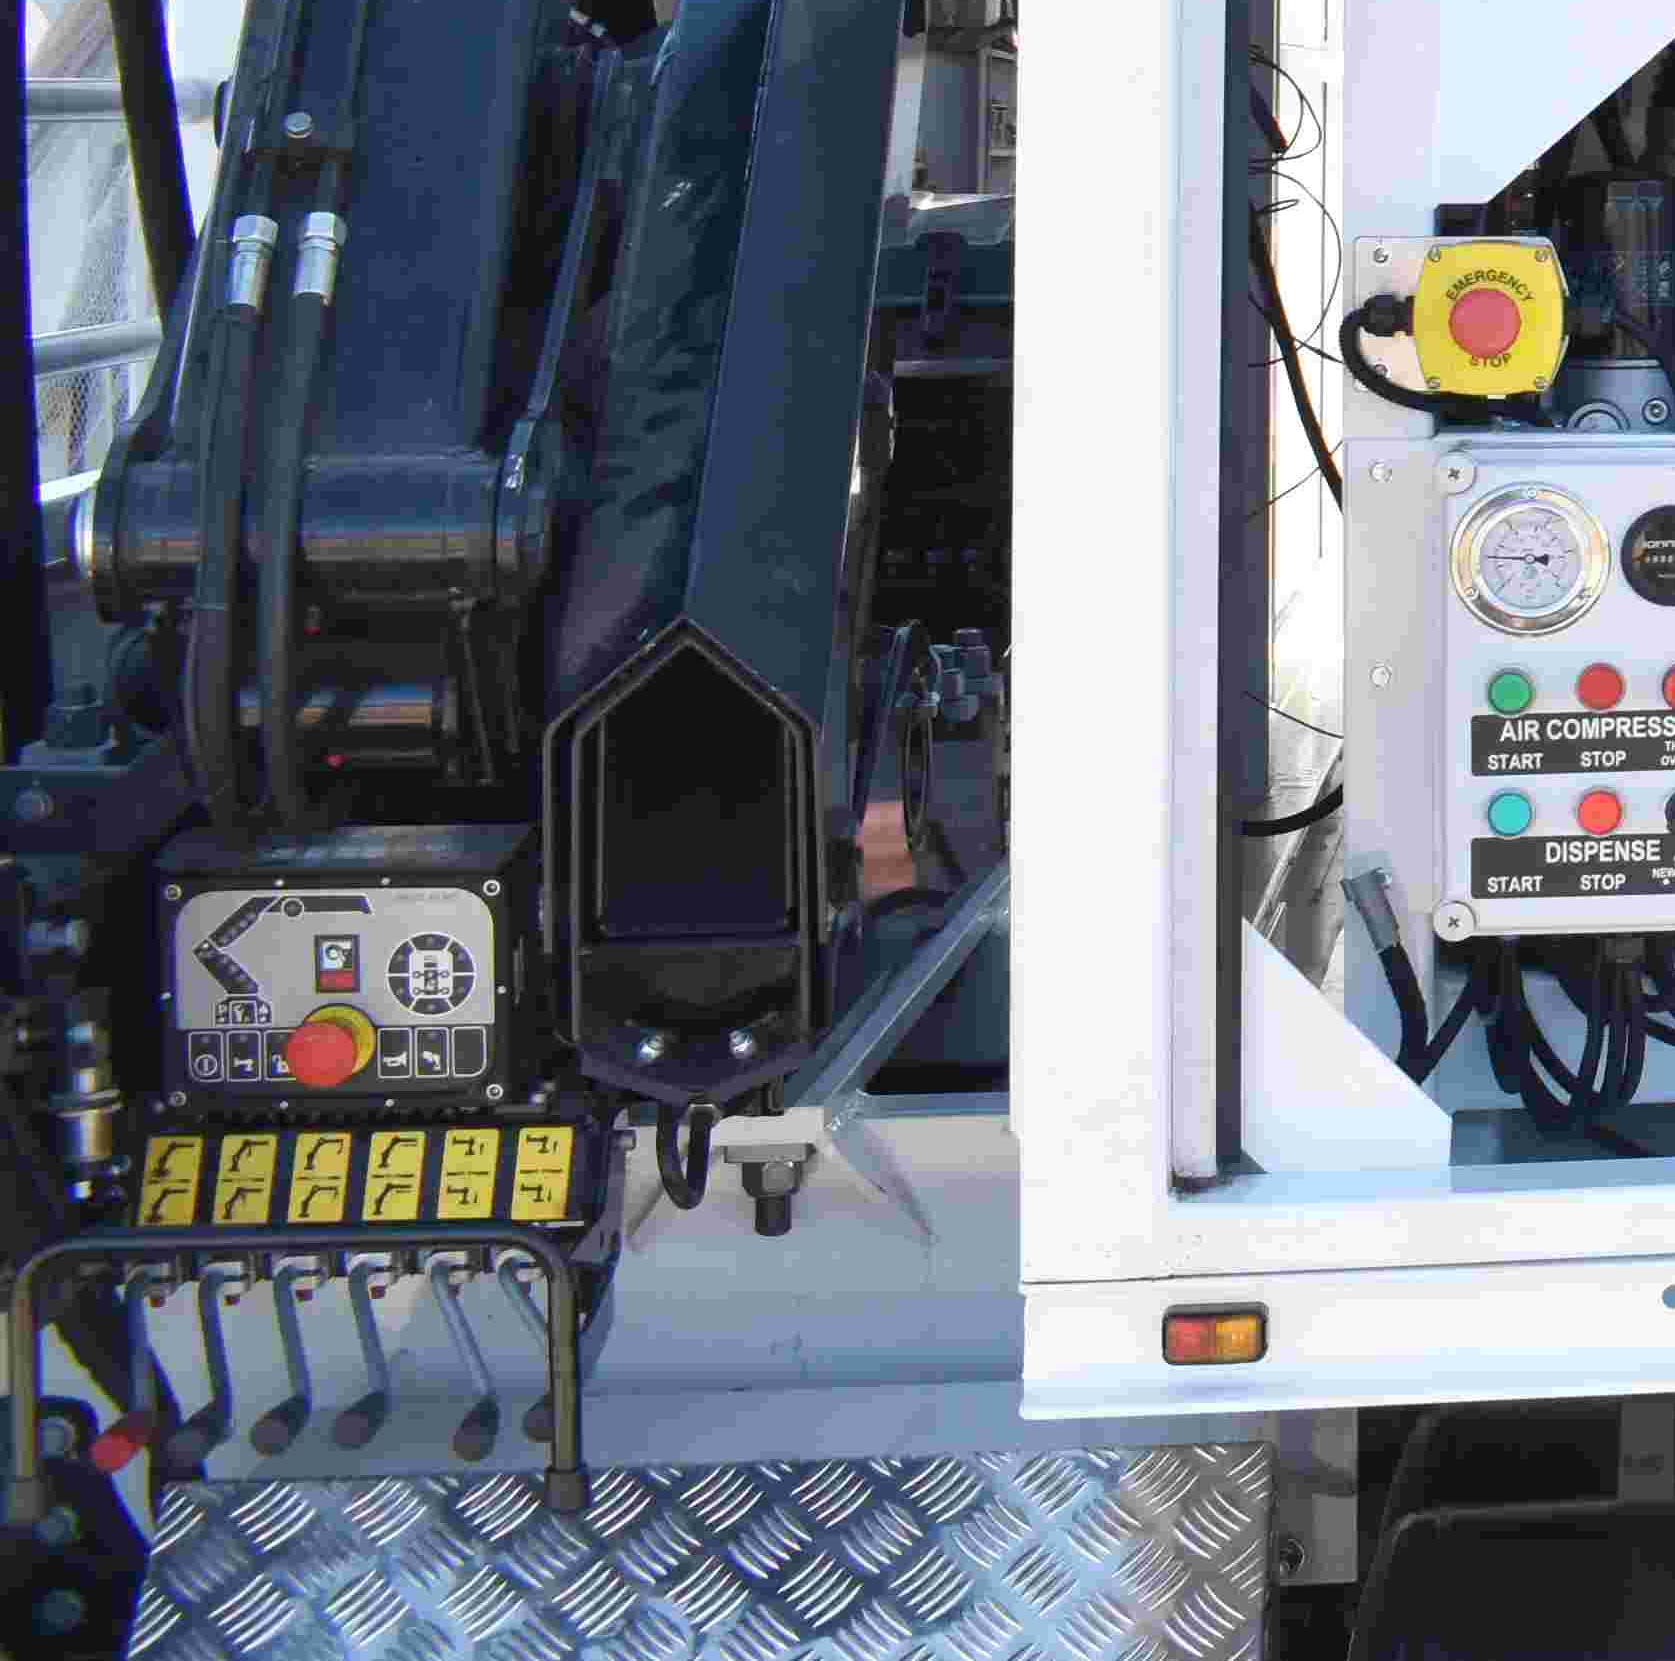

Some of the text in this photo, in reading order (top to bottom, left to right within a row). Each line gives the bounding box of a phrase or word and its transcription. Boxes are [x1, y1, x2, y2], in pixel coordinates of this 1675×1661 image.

[1445, 269, 1536, 301] EMERGENCY
[1499, 719, 1541, 742] AIR
[1487, 754, 1543, 770] START
[1580, 751, 1626, 768] STOP
[1545, 839, 1661, 864] DISPENSE
[1487, 876, 1543, 892] START
[1580, 873, 1626, 890] STOP
